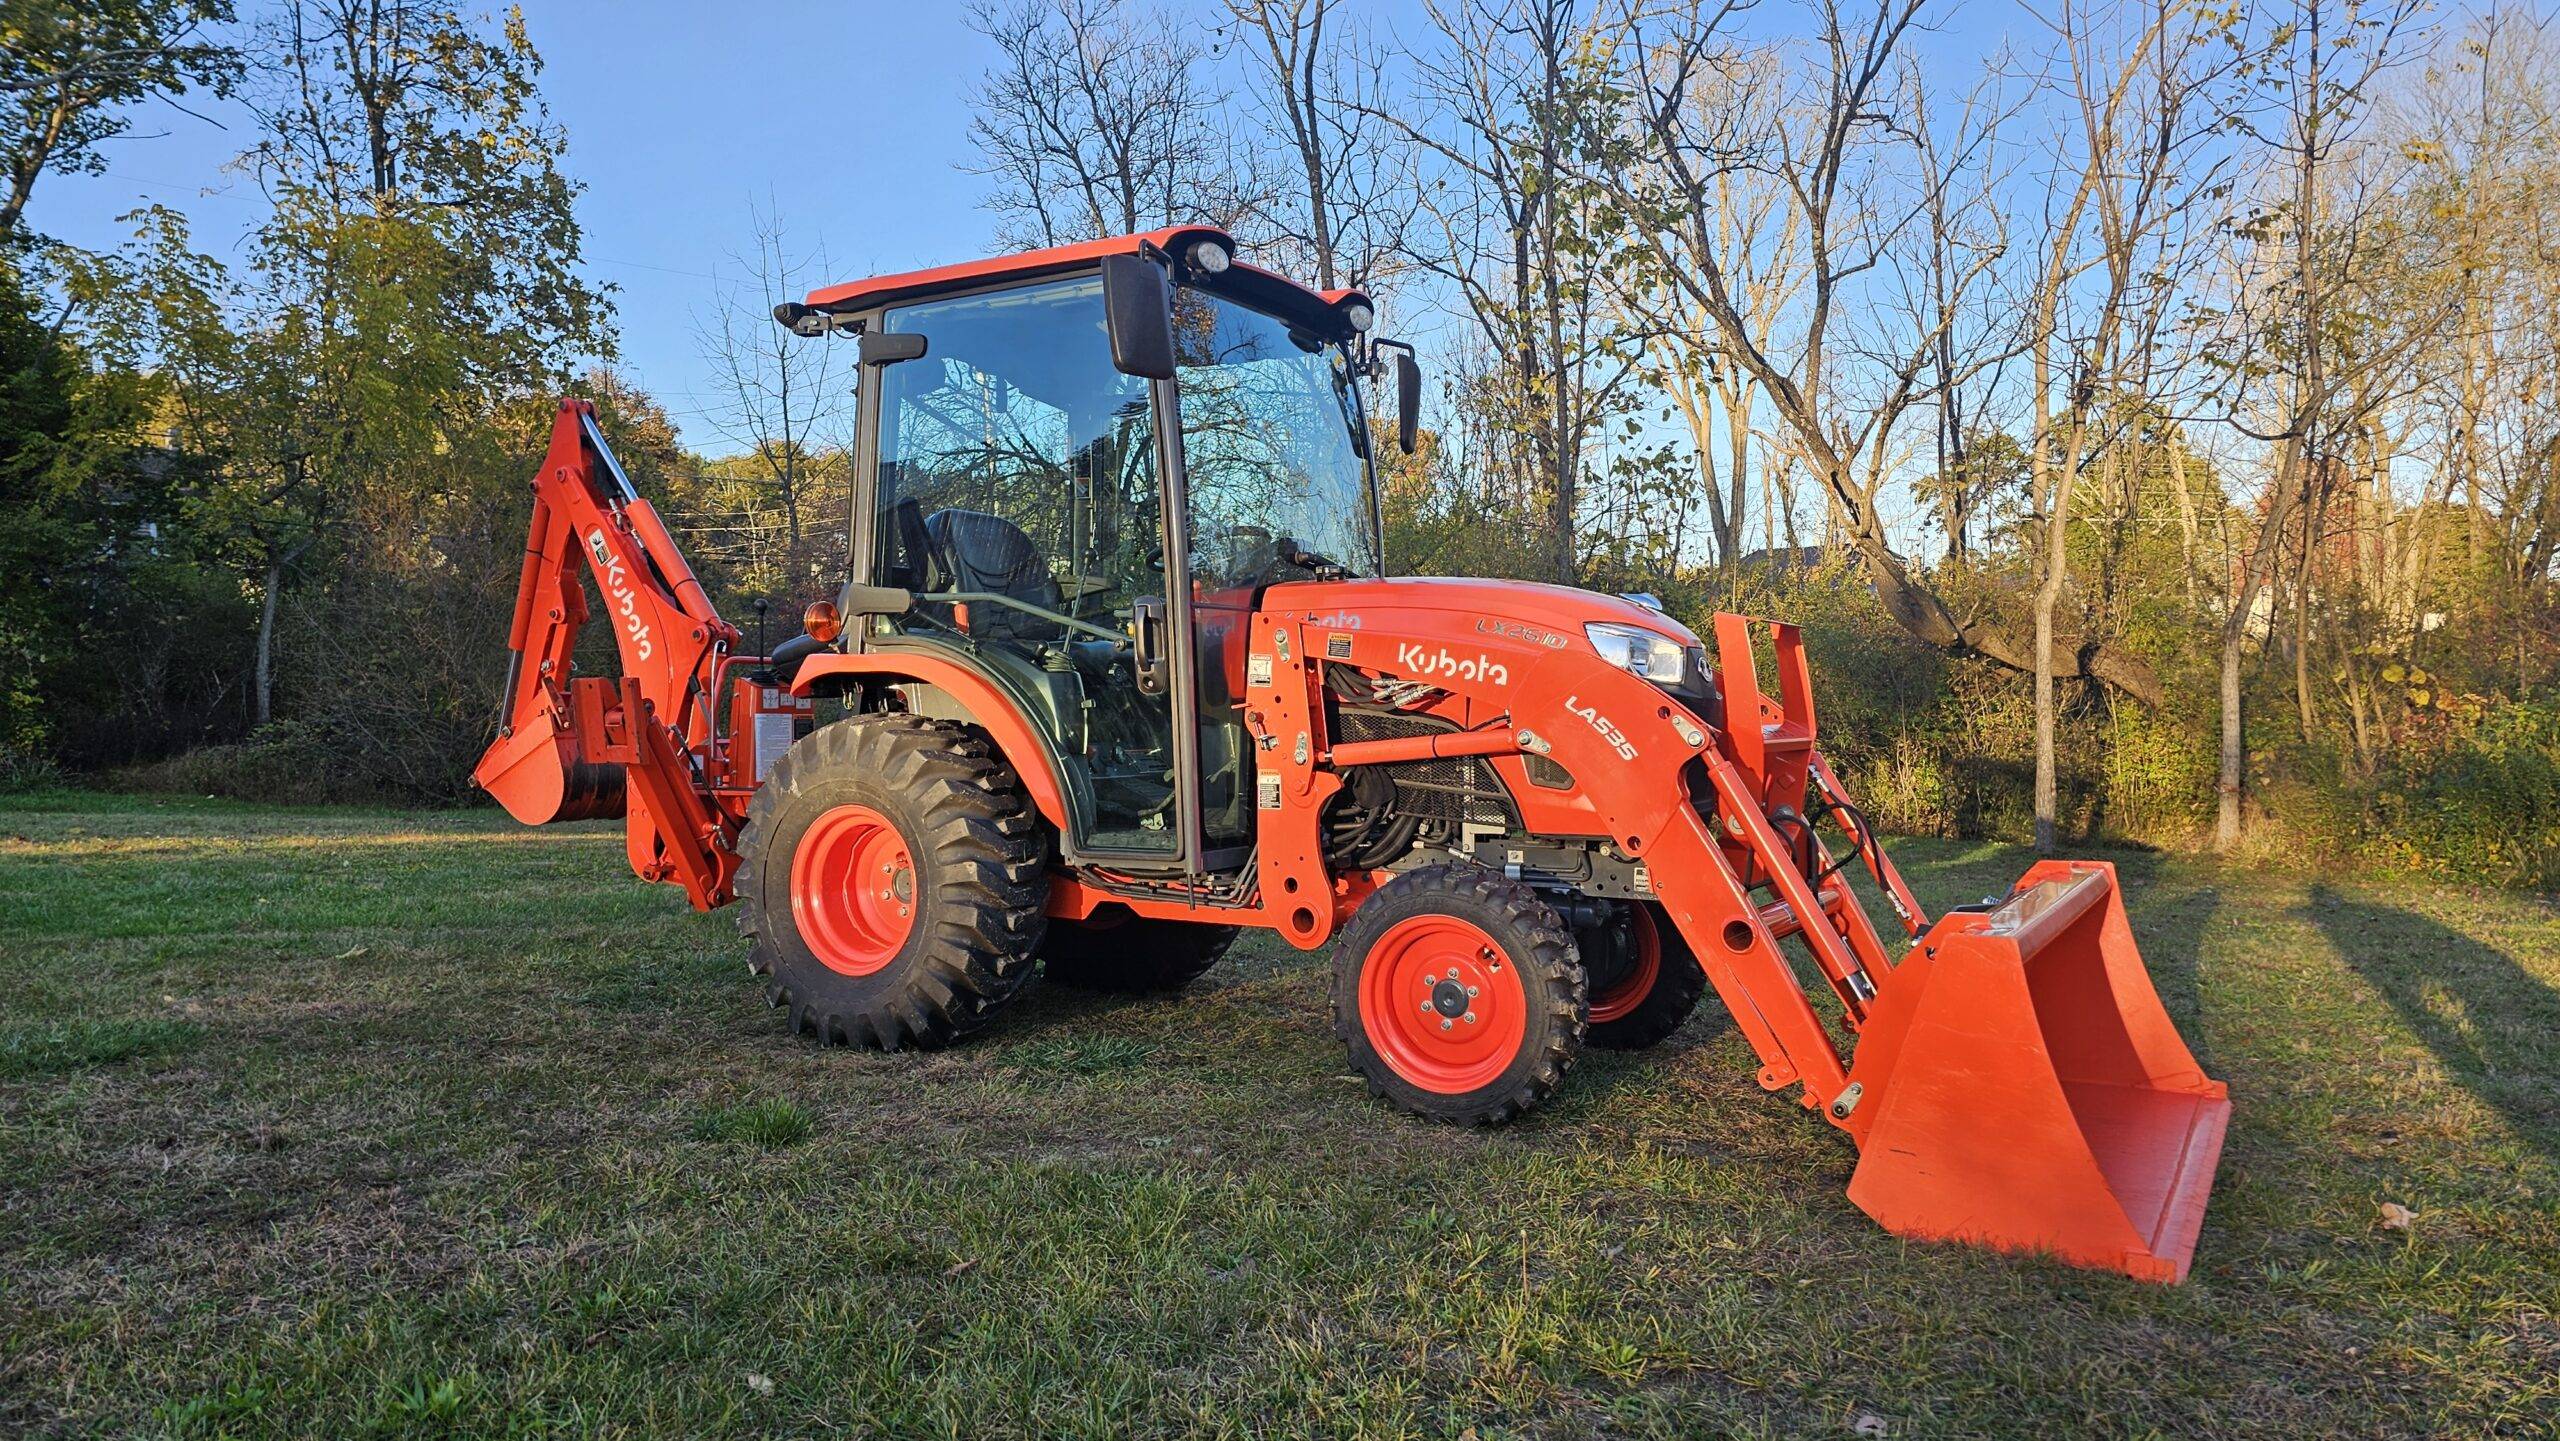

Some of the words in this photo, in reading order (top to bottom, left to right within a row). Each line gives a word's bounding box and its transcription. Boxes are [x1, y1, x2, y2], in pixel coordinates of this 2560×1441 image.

[607, 555, 651, 660] Kubota
[1476, 619, 1568, 648] LX2610
[1398, 643, 1508, 685] Kubota
[1565, 695, 1639, 761] LA535
